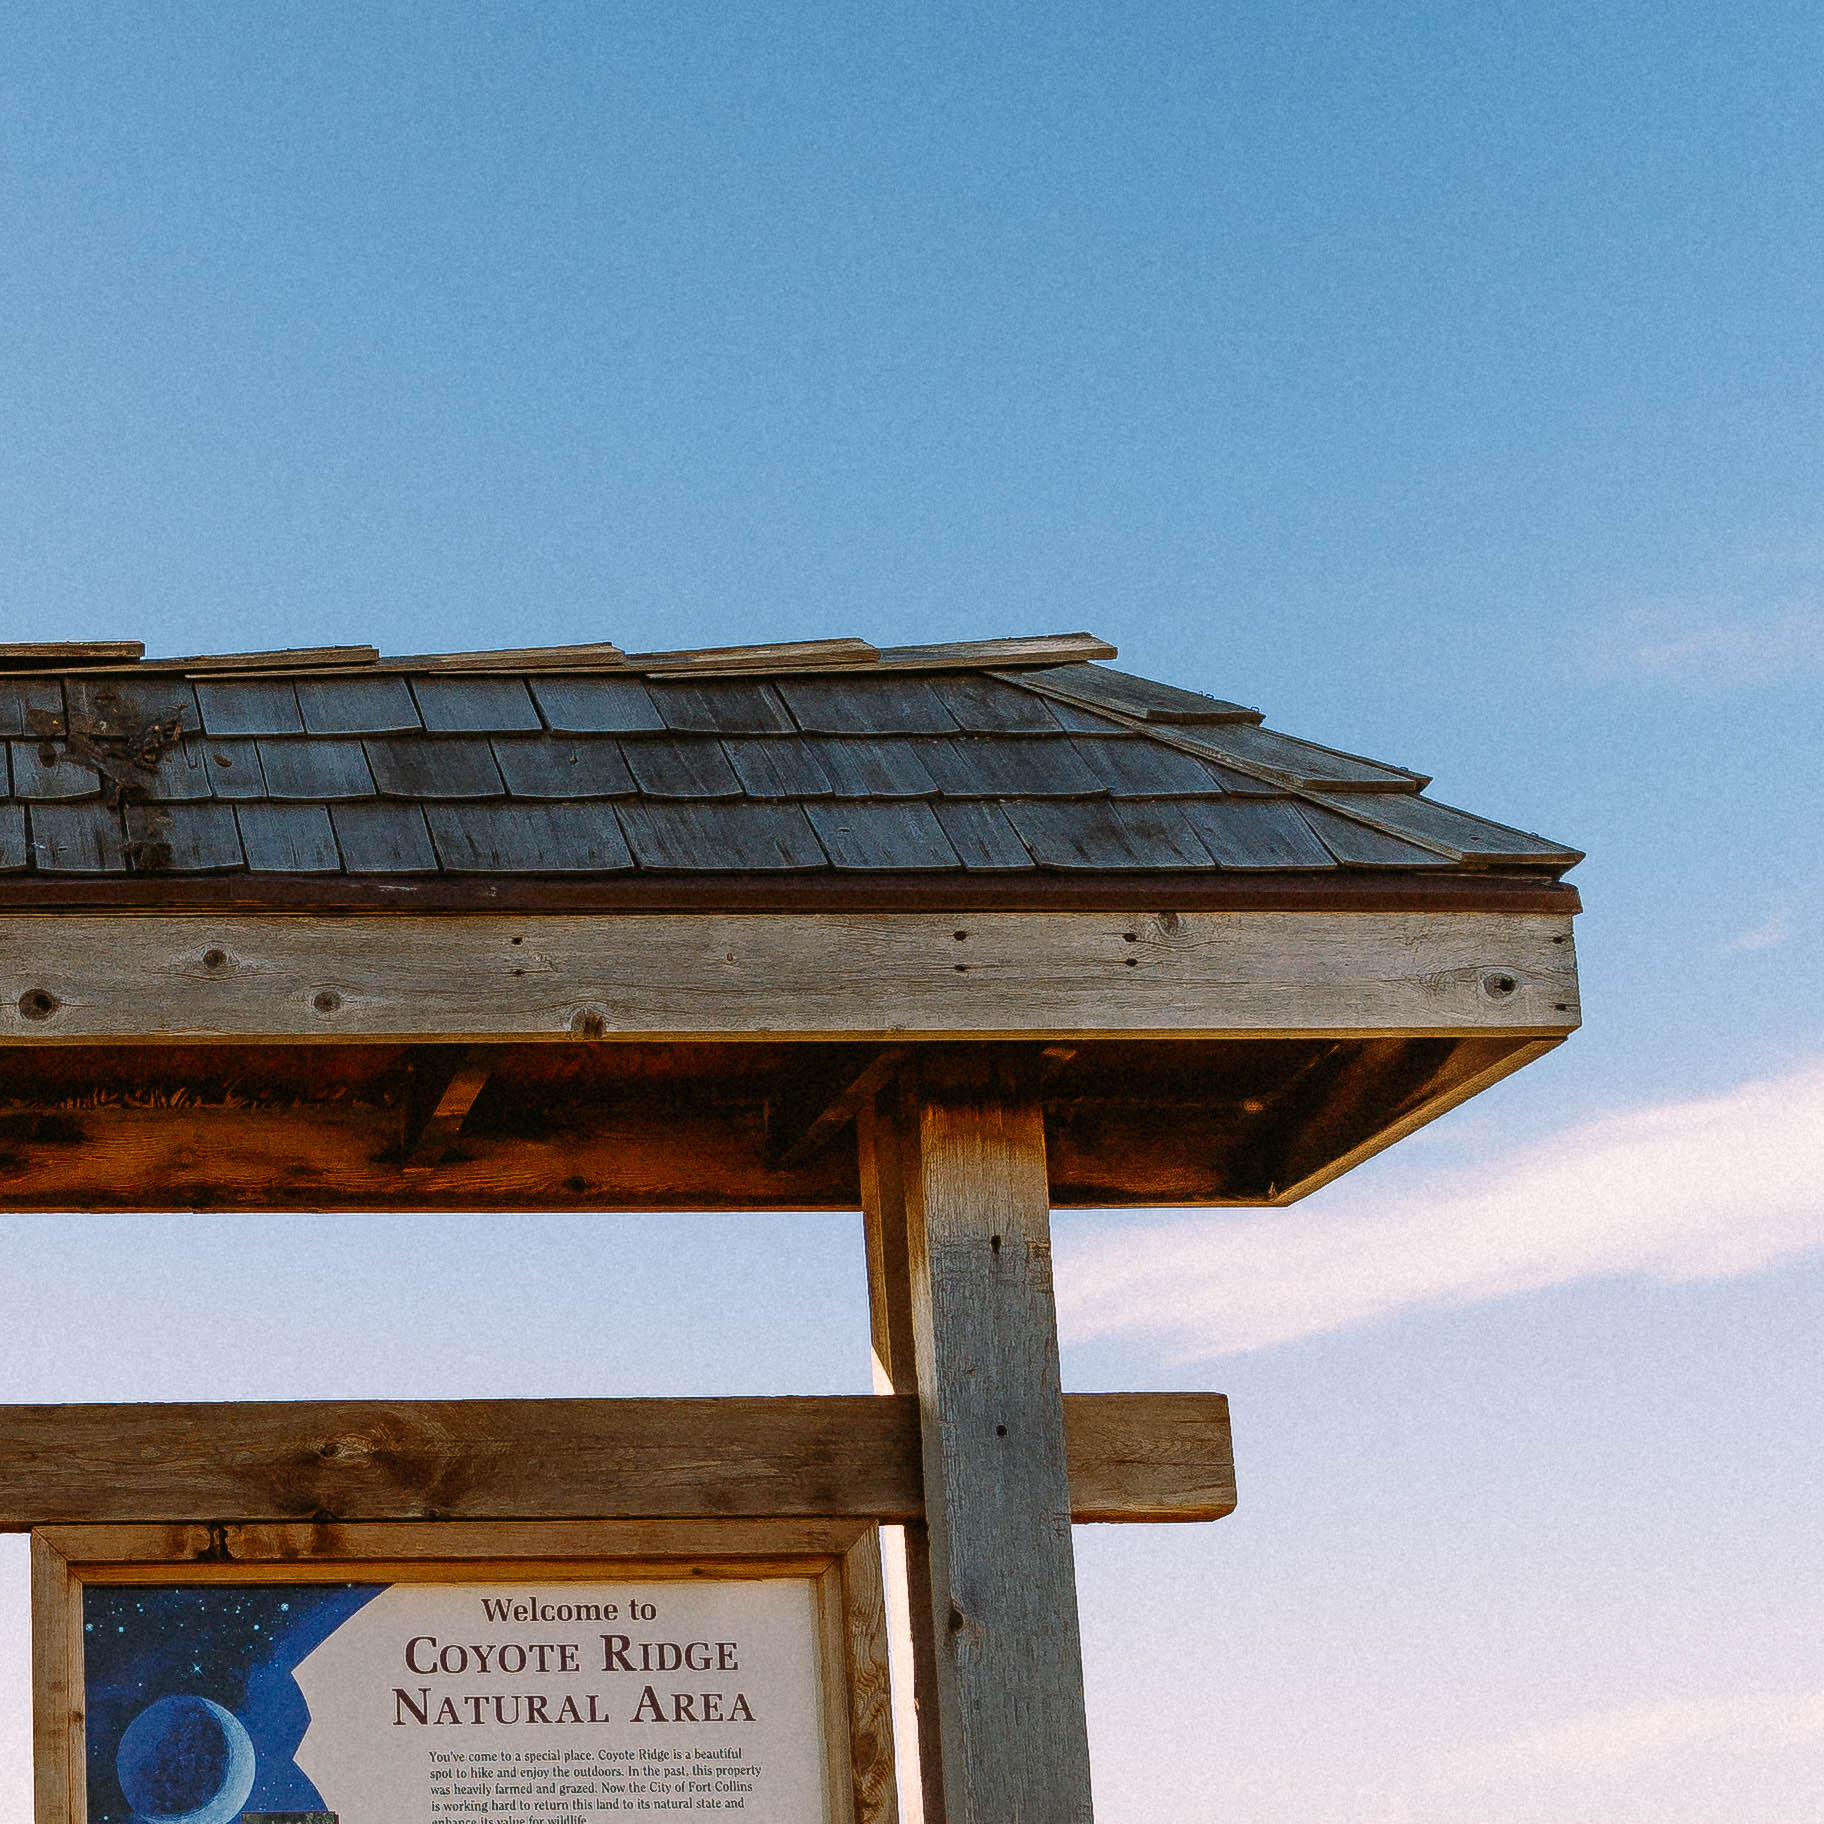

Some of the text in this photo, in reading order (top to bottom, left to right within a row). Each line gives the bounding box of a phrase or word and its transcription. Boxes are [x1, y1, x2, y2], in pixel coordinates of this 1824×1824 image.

[480, 1596, 656, 1621] Welcome to
[405, 1634, 738, 1674] COYOTE RIDGE
[391, 1685, 756, 1724] NATURAL AREA
[428, 1747, 742, 1763] You've come to a special place. Coyote Ridge is a beautiful
[429, 1763, 761, 1781] spot to hike and enjoy the outdoors. In the past, this property
